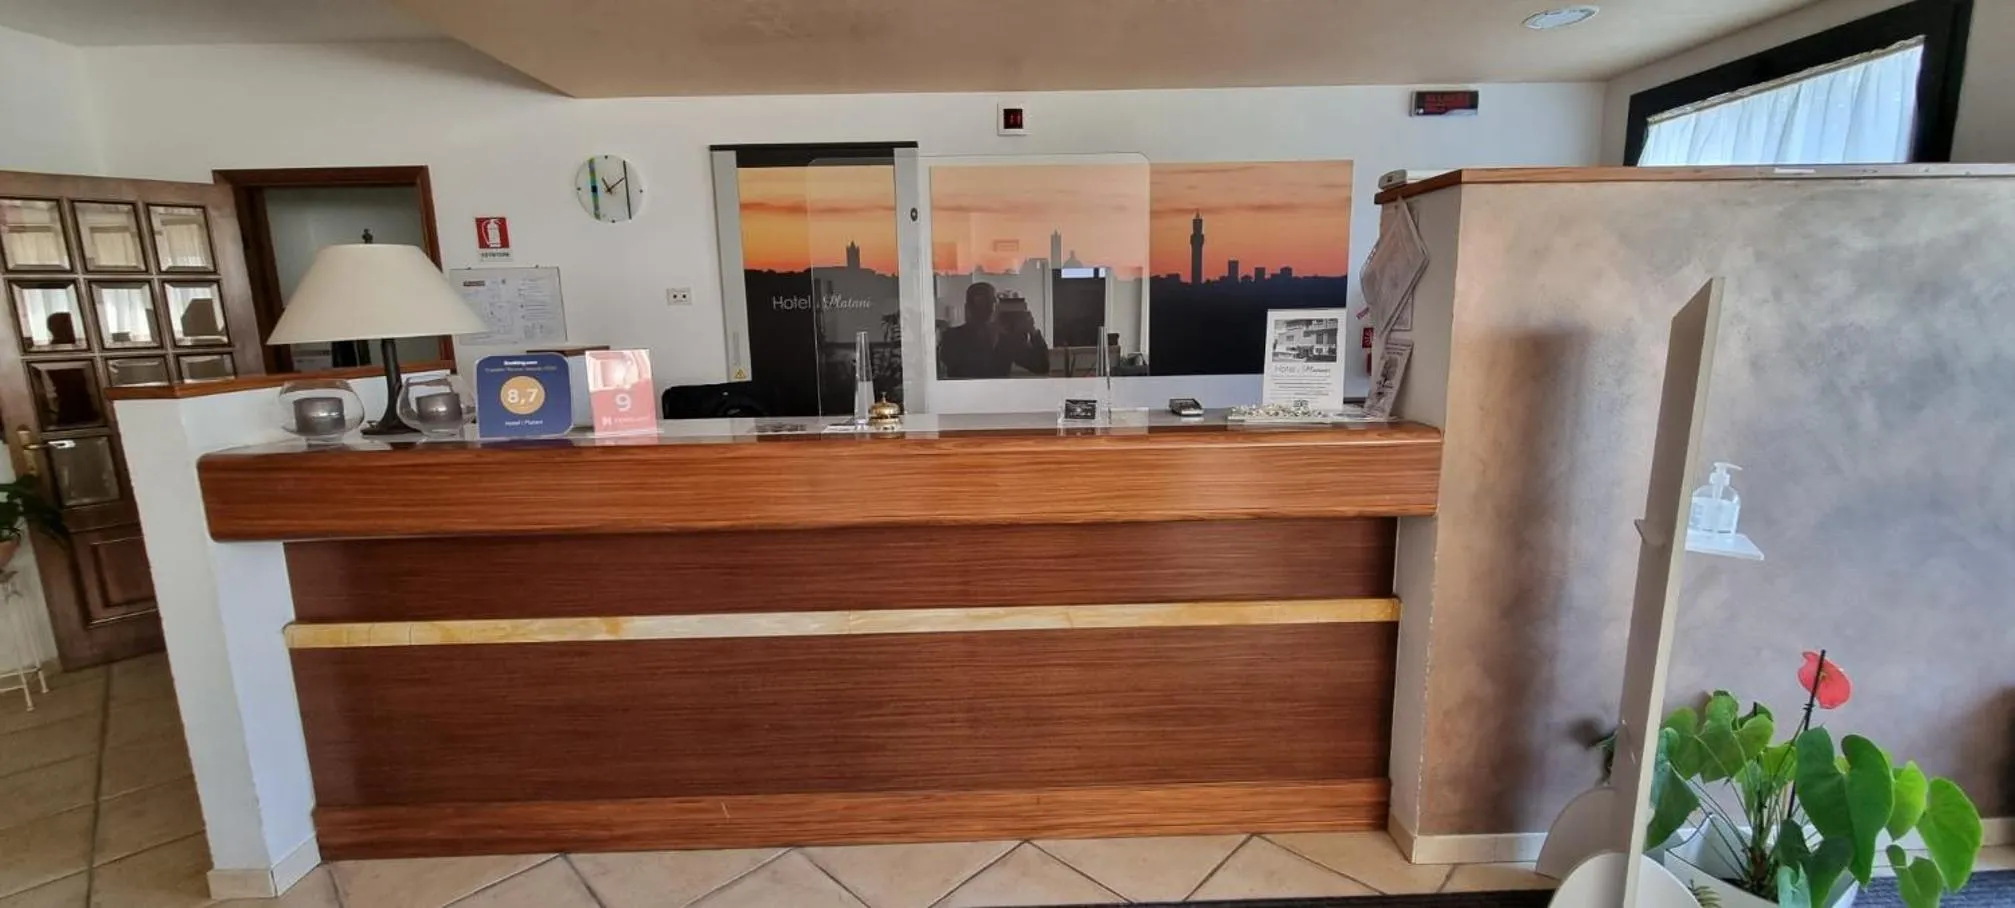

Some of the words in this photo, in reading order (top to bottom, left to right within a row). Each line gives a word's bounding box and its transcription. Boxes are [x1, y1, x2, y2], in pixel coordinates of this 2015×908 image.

[772, 294, 811, 310] Hotel
[822, 291, 872, 310] Platani
[507, 388, 539, 405] 8,7
[615, 393, 631, 412] 9
